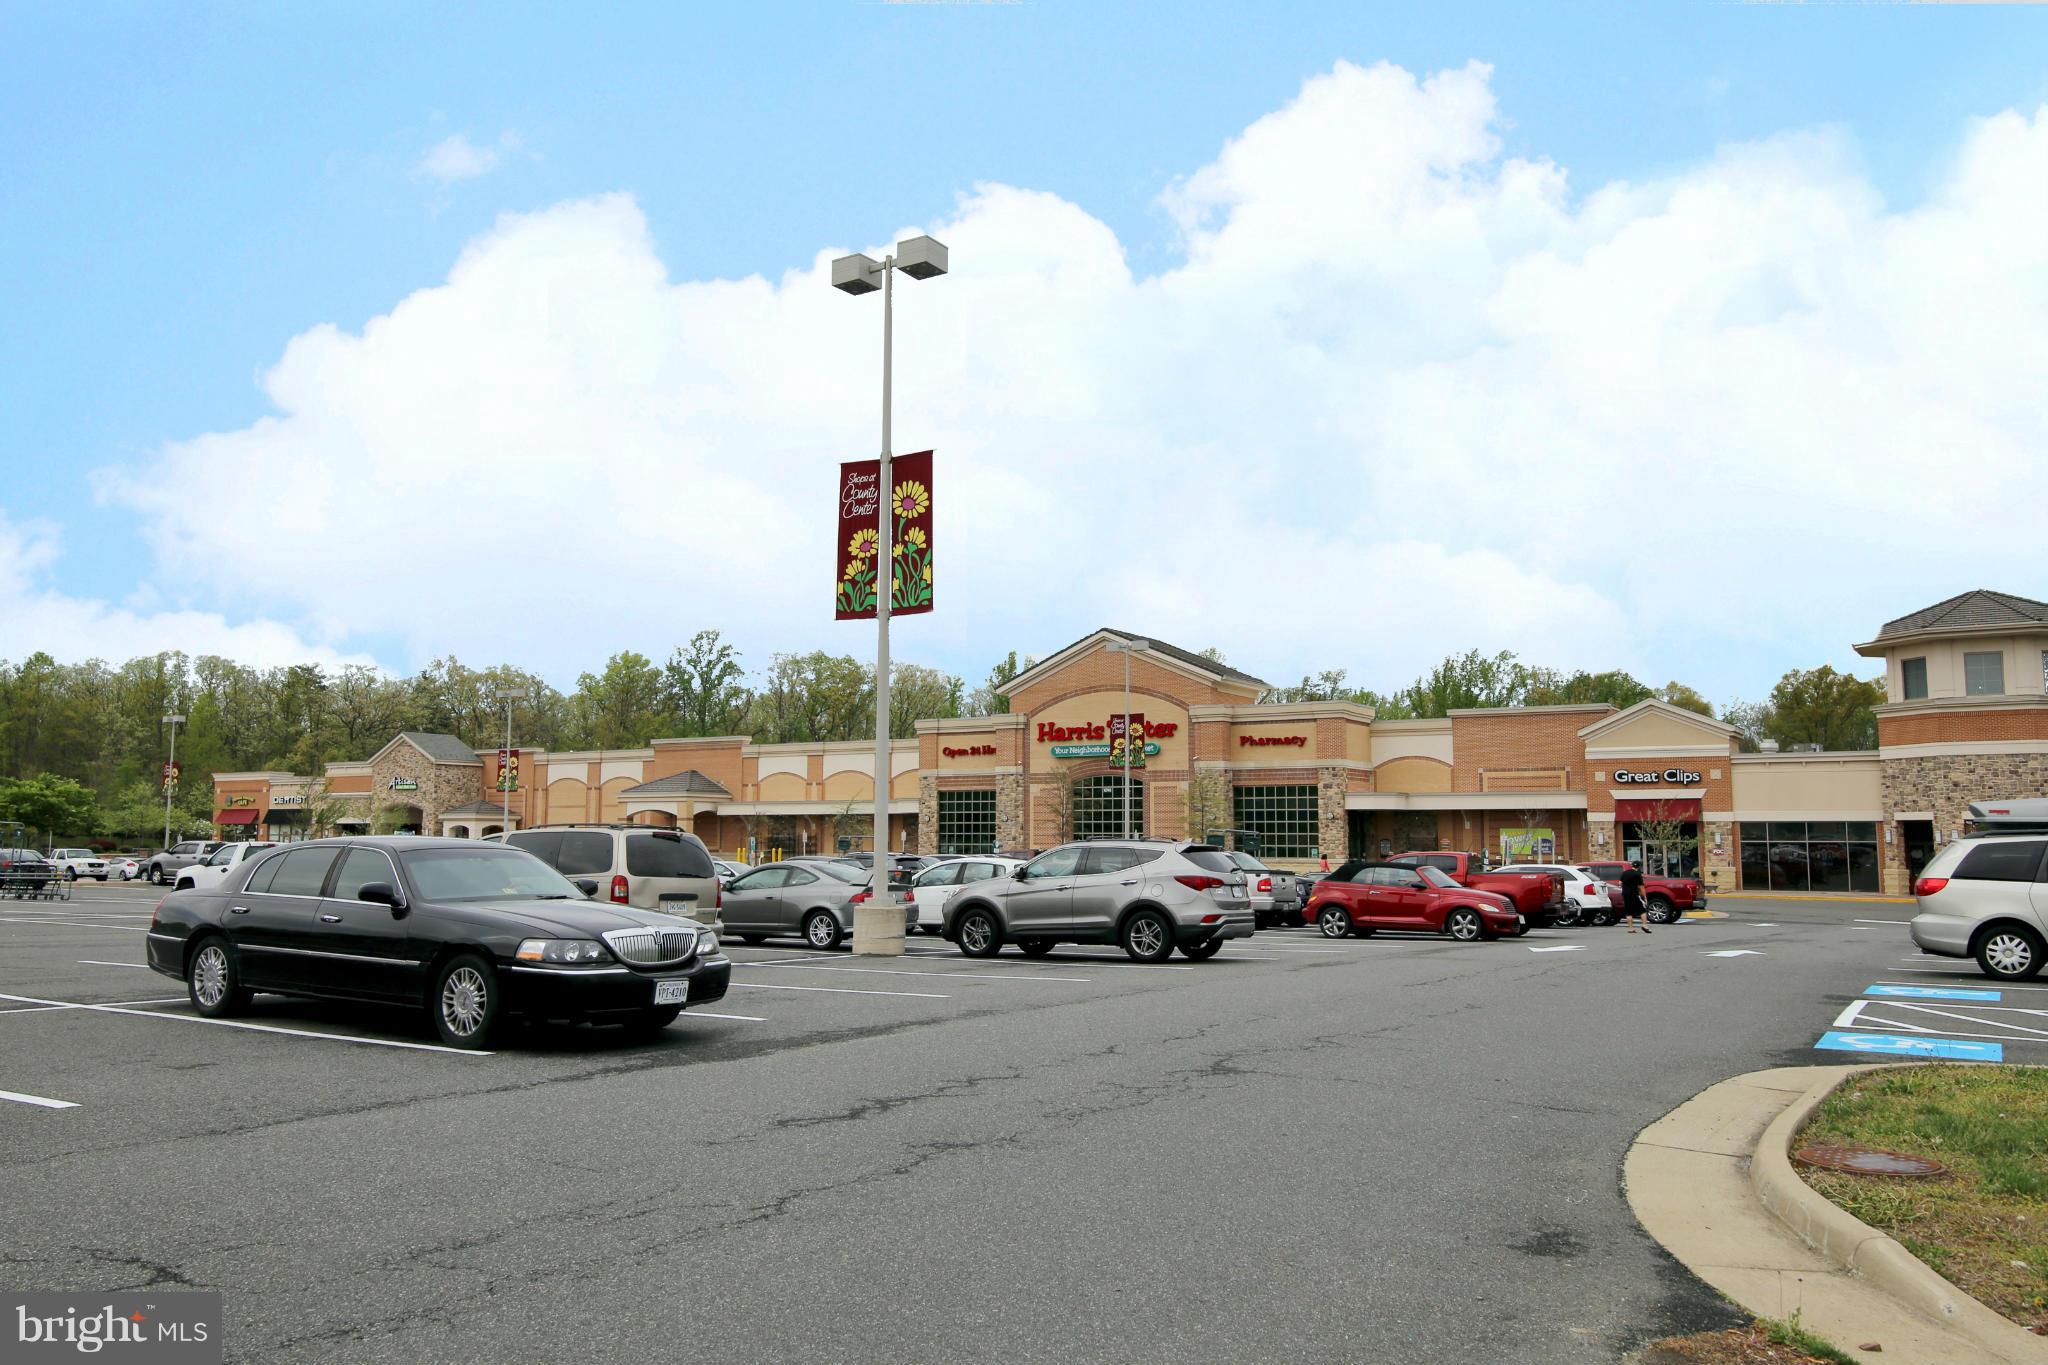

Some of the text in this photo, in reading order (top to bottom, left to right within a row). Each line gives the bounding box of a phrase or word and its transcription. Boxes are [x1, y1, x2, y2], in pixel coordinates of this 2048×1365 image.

[848, 472, 868, 485] Shops
[842, 484, 878, 503] County
[843, 500, 876, 518] Center
[1037, 721, 1105, 742] Harris
[1240, 735, 1307, 747] Pharmacy
[943, 747, 969, 759] Open
[1054, 746, 1069, 754] Your
[1614, 769, 1701, 785] Great Clips
[272, 795, 306, 805] DENTIST
